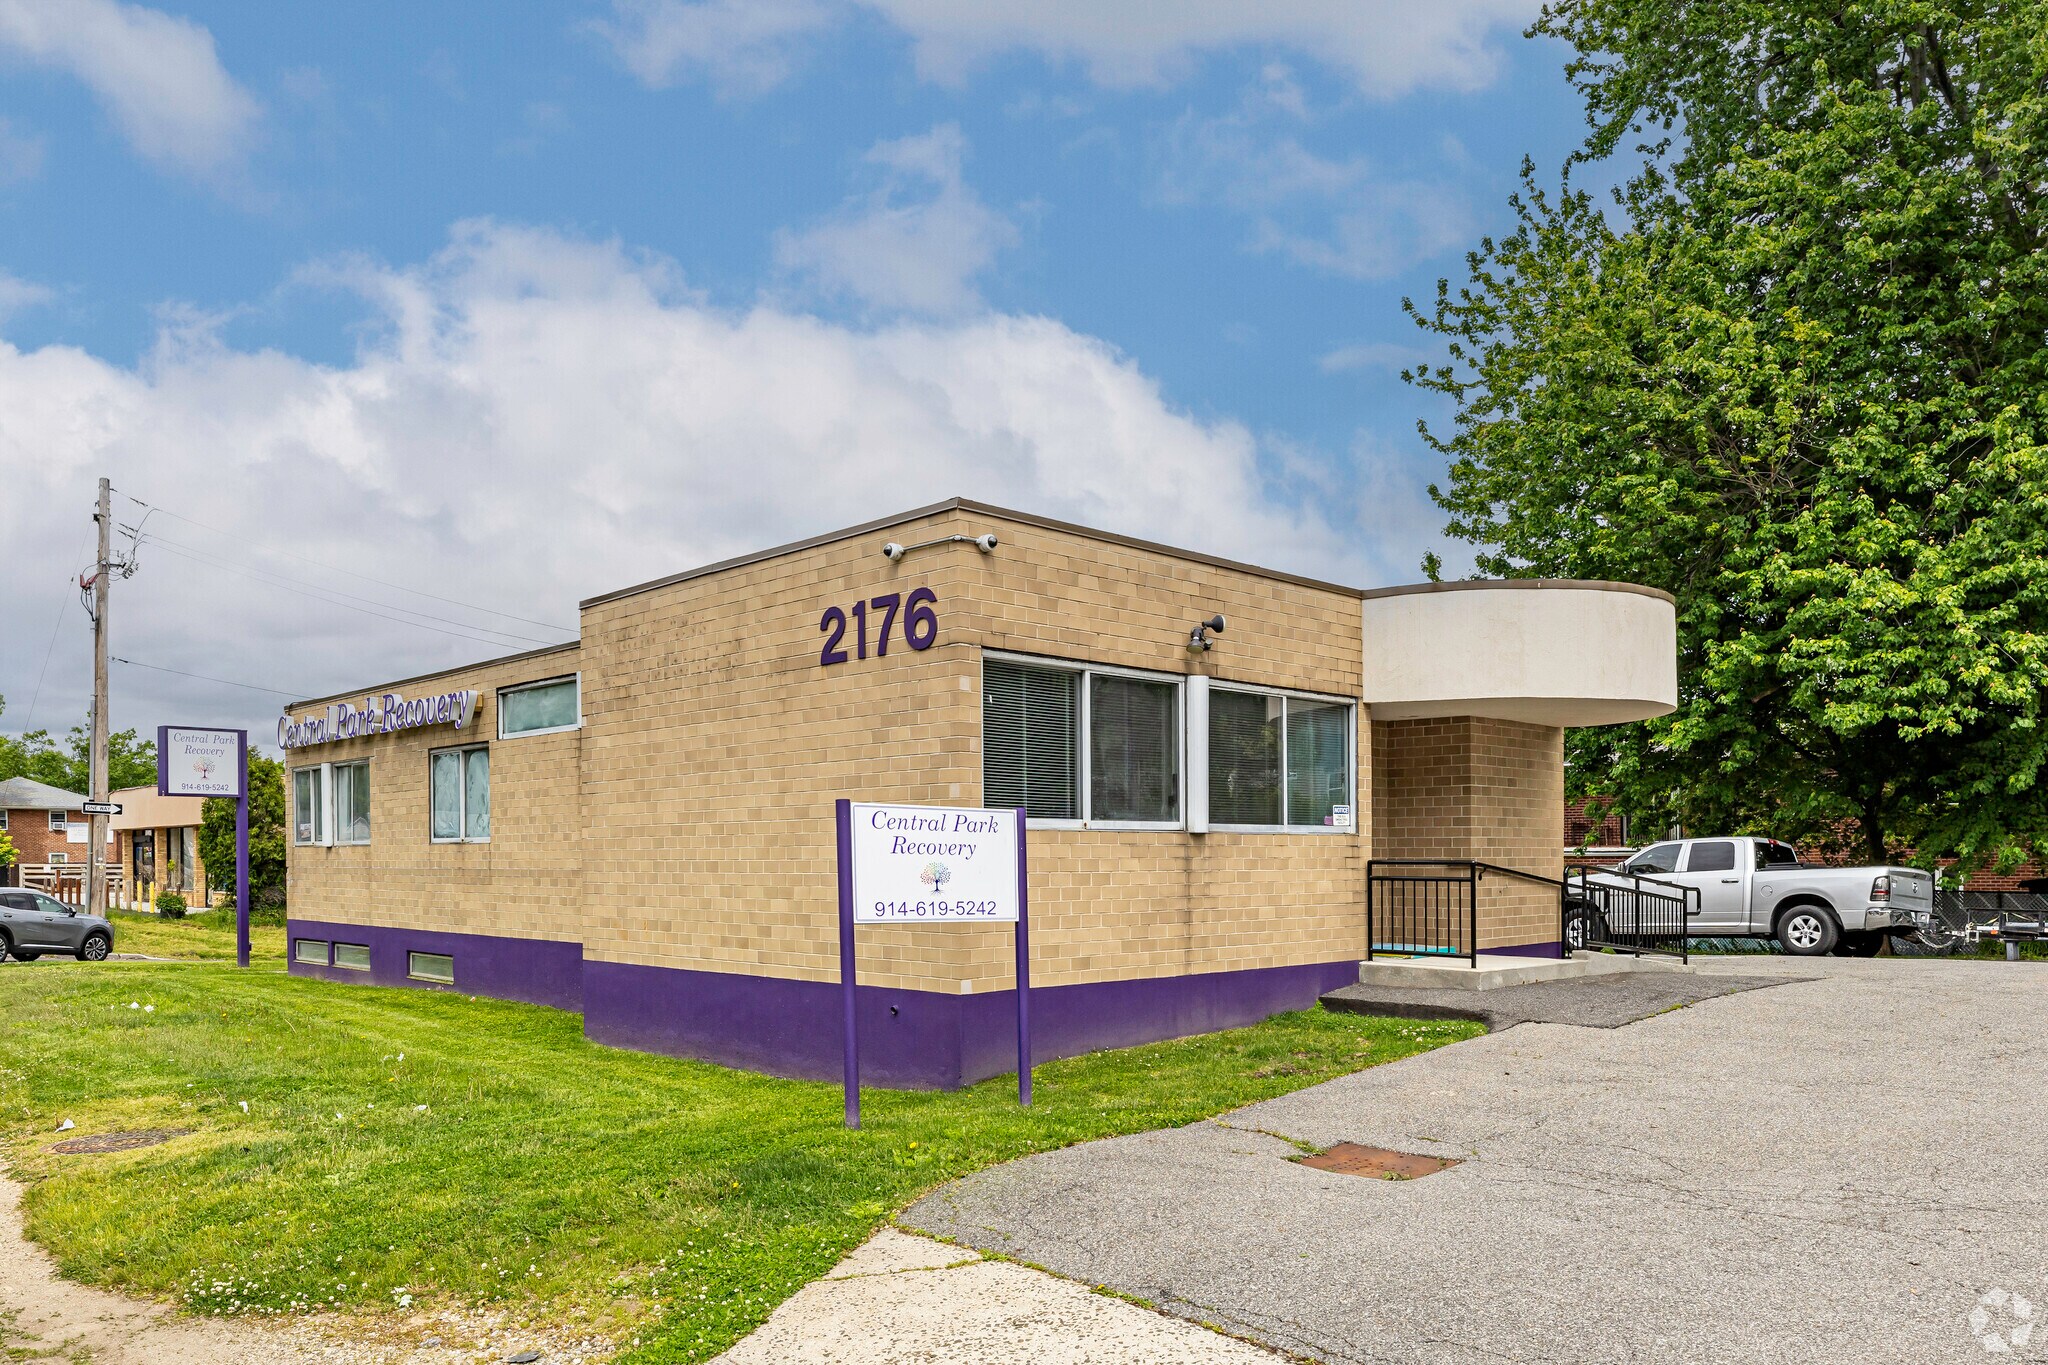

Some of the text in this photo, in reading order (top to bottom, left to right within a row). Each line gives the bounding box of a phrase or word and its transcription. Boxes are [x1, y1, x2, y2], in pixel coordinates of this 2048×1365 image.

[820, 587, 938, 666] 2176
[276, 689, 470, 750] Central Park Recovery
[173, 732, 235, 745] Central Park
[184, 744, 225, 757] Recovery
[181, 782, 229, 791] 914-619-5242
[871, 810, 999, 834] Central Park
[890, 835, 977, 860] Recovery
[874, 900, 997, 917] 914-619-5242
